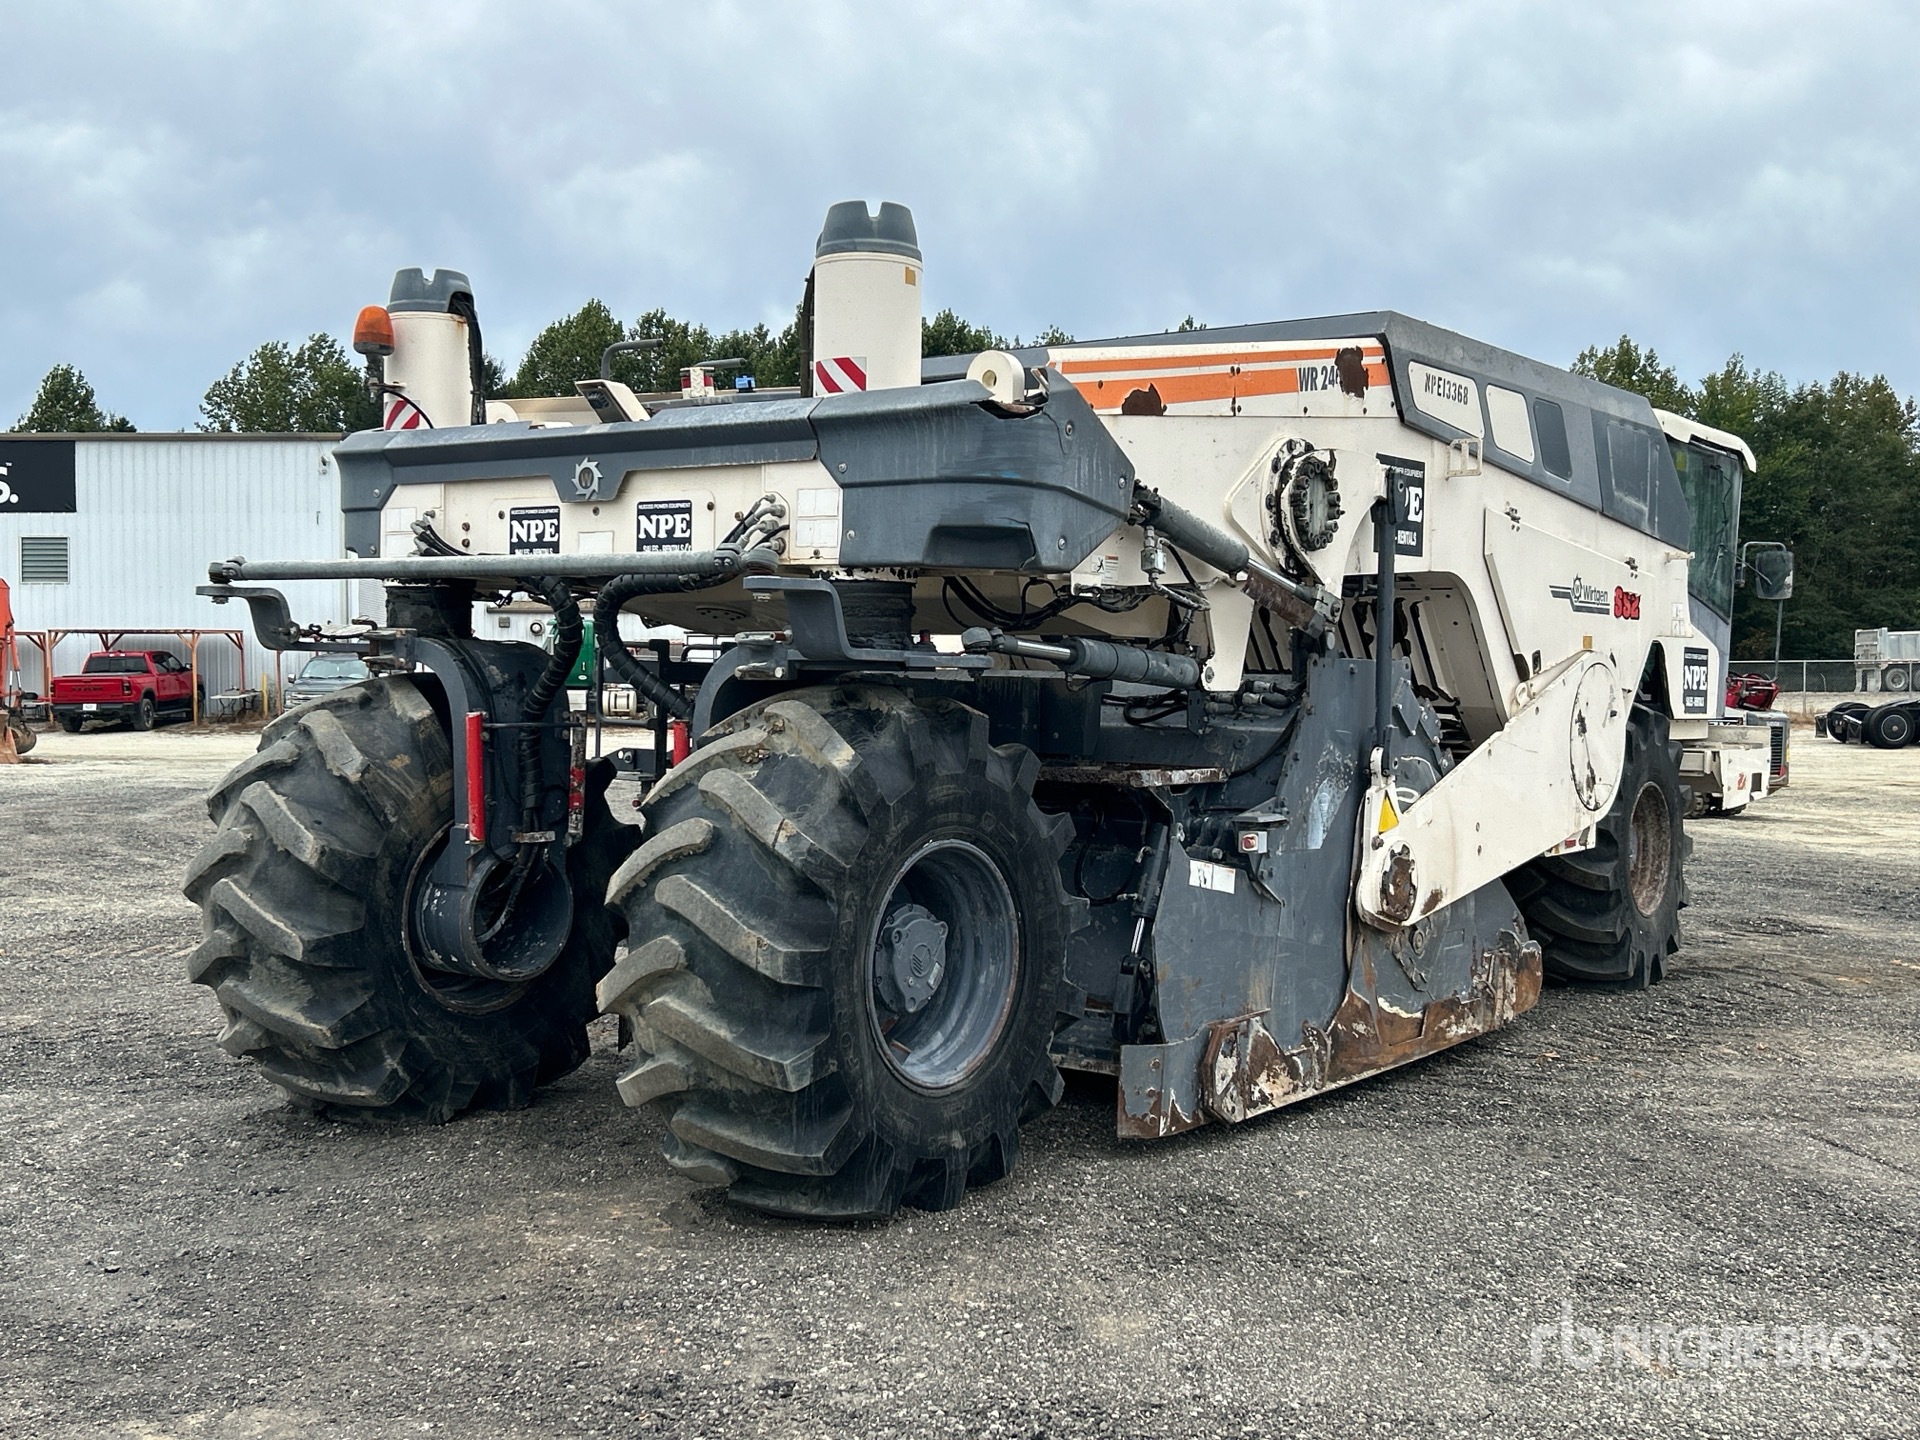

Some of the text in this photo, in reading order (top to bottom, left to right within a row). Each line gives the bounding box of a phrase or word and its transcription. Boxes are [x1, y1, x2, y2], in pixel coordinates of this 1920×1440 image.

[1298, 366, 1318, 392] WR
[511, 519, 559, 542] NPE
[638, 513, 691, 539] NPE
[1583, 585, 1609, 606] Wirtgen
[1684, 665, 1708, 690] NPE
